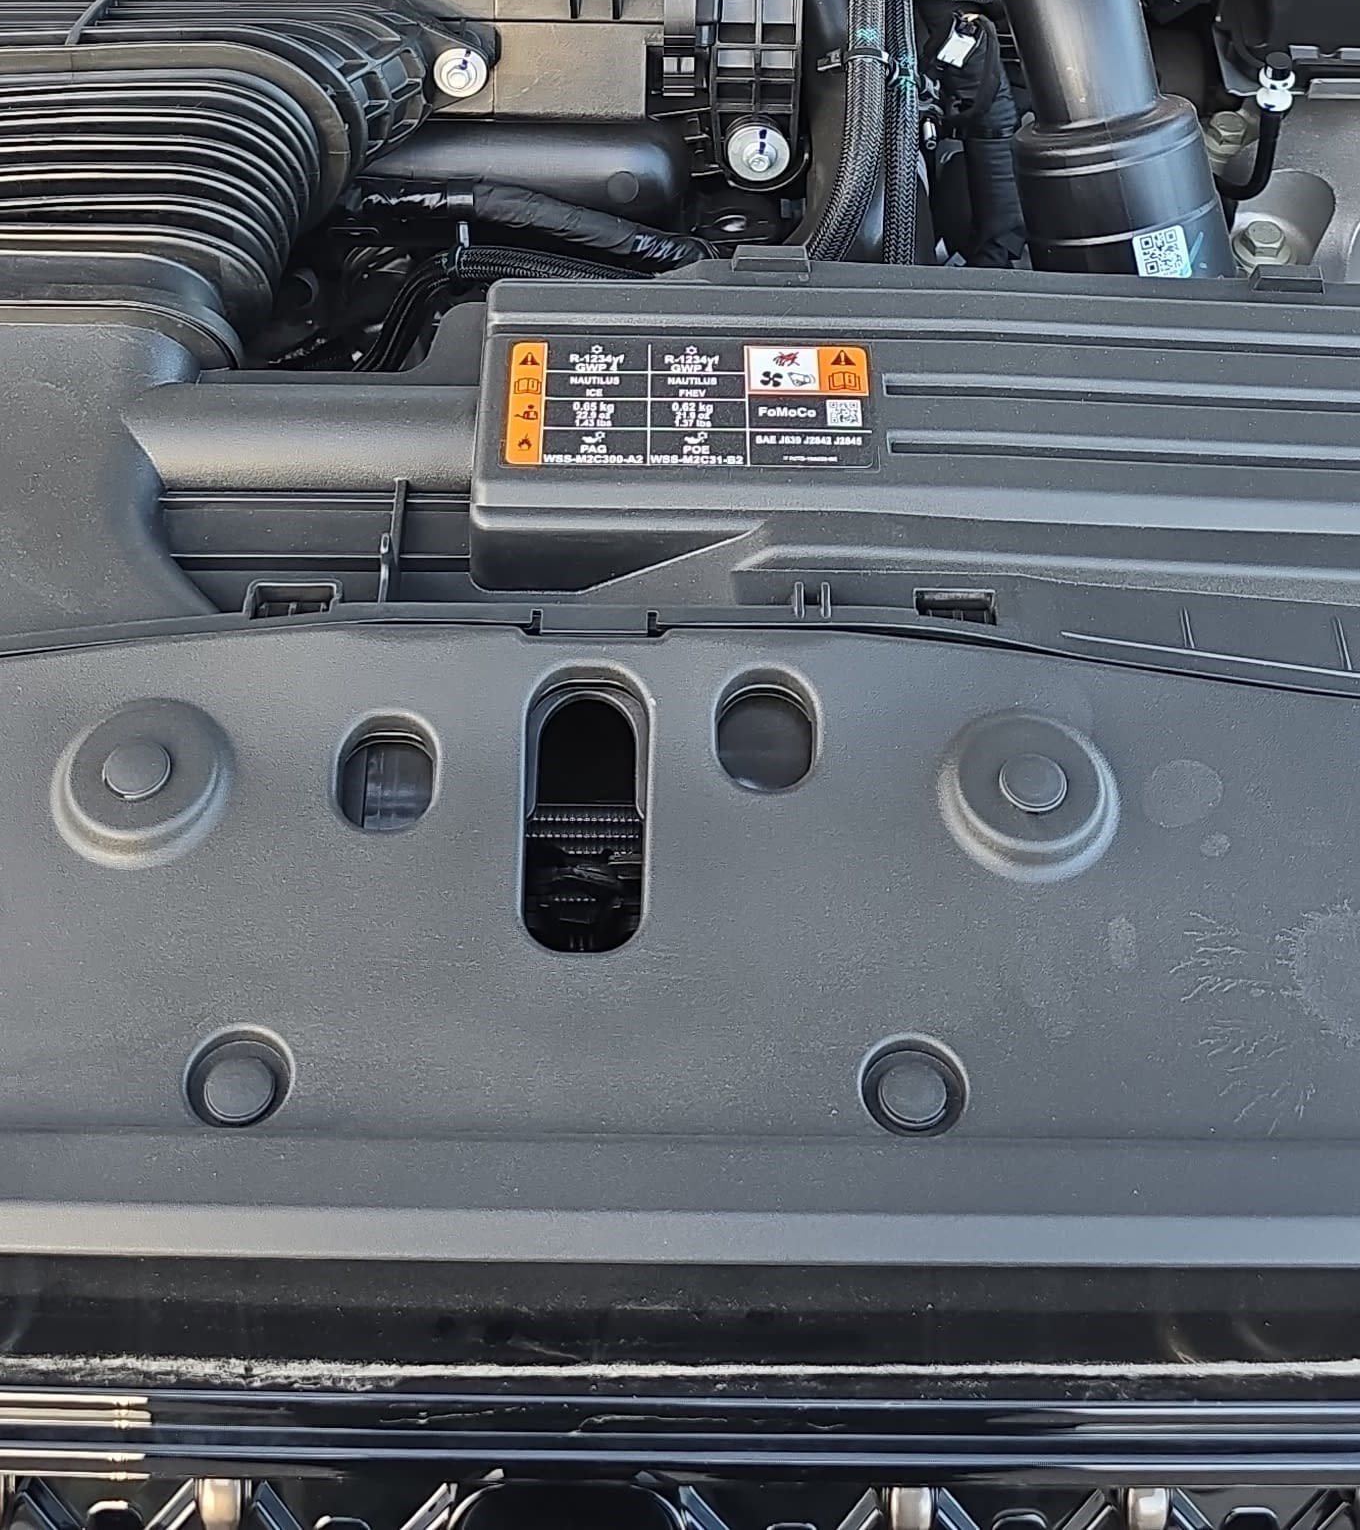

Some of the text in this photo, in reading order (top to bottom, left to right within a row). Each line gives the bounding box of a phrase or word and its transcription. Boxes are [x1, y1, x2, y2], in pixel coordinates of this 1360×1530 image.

[569, 354, 625, 367] R-1234yf
[664, 355, 719, 368] R-1234yf
[671, 364, 702, 372] GWP
[570, 376, 620, 385] NAUTILUS
[667, 377, 718, 386] NAUTILUS
[586, 388, 603, 397] ICE
[678, 389, 706, 397] FHEV
[572, 402, 615, 414] 0.65 kg
[672, 402, 713, 414] 0.62 kg
[758, 406, 816, 418] FoMoCo
[696, 420, 712, 428] lbs
[756, 435, 776, 444] SAE
[580, 445, 607, 454] PAG
[682, 446, 710, 454] POE
[543, 454, 643, 464] WSS-M2C300-A2
